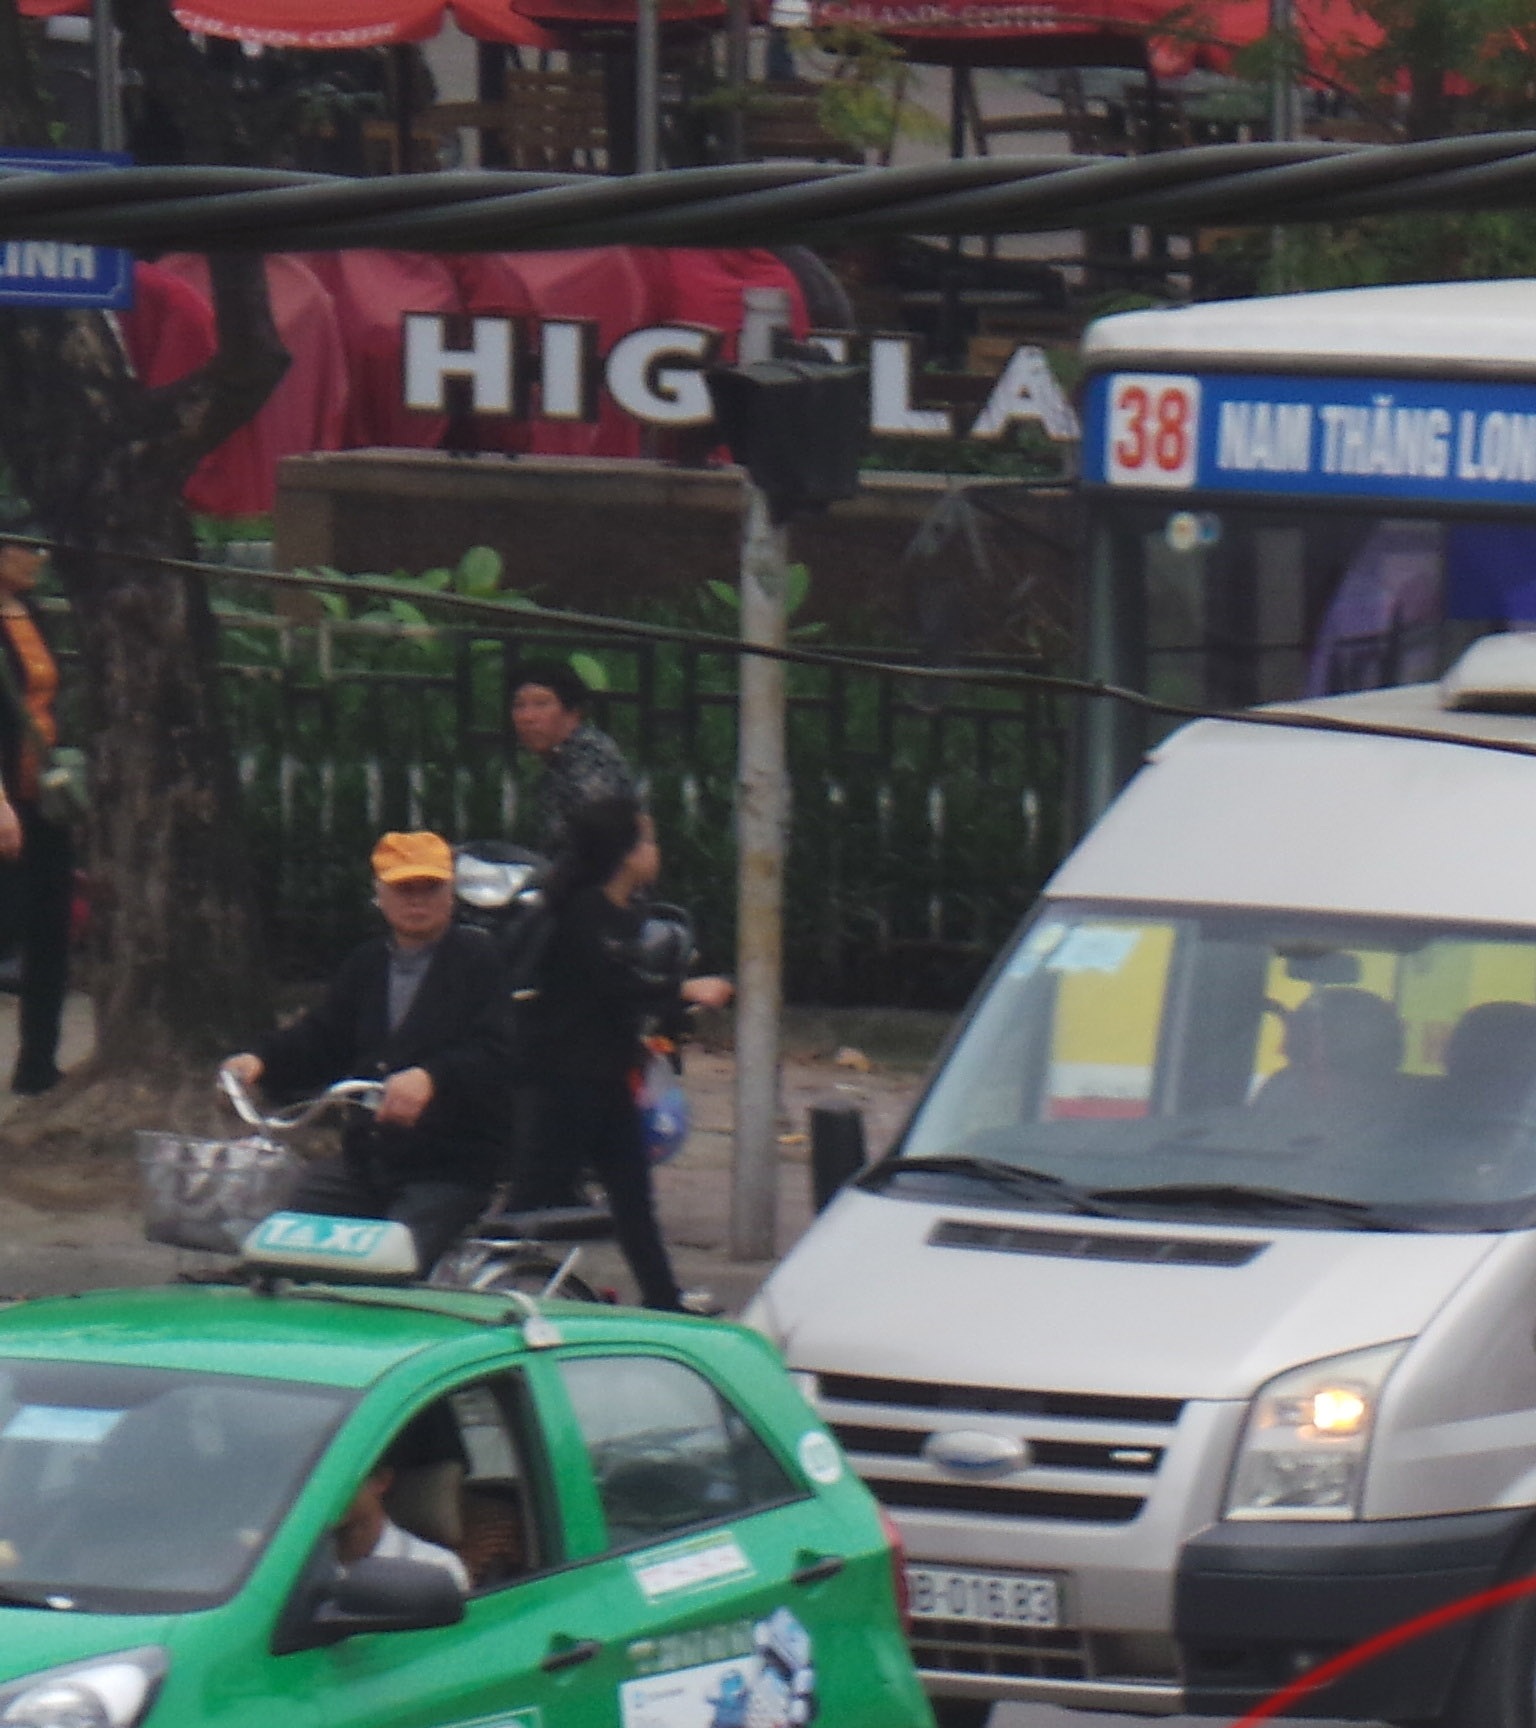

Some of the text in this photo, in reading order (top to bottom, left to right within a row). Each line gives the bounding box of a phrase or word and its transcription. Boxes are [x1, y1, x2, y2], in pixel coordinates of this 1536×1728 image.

[0, 240, 95, 279] INH
[404, 312, 1082, 442] HIGLA
[1115, 385, 1191, 472] 38
[1217, 400, 1313, 474] NAM
[1321, 393, 1452, 480] THĂNG
